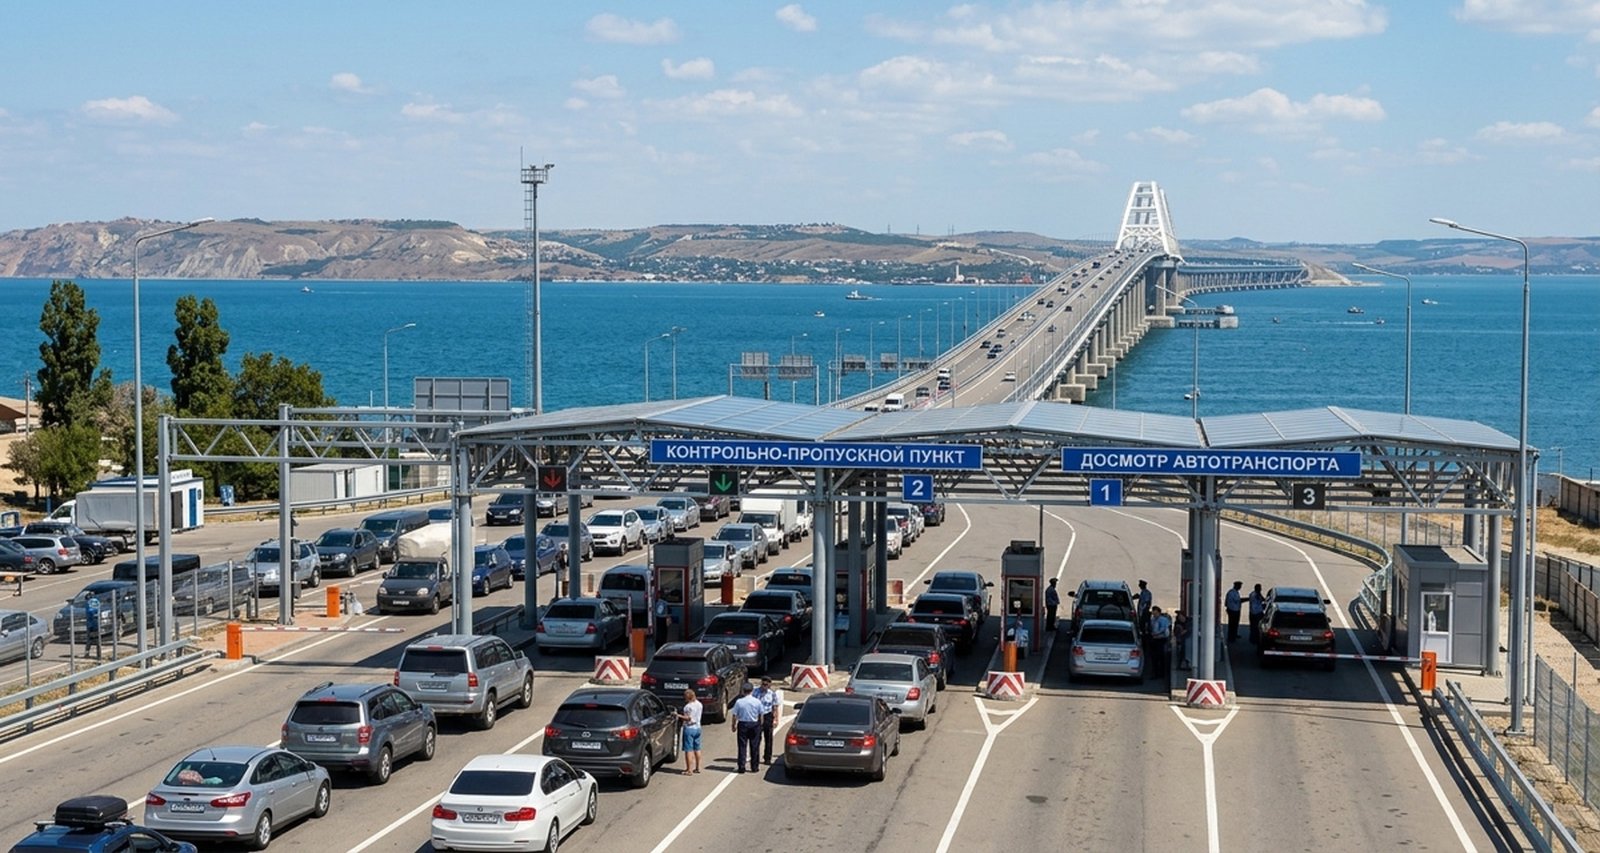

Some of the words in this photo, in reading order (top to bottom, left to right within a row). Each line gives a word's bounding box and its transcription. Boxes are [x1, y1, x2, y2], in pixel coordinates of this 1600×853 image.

[666, 444, 905, 463] КОНТРОЛЬНО-ПРОПУСКНОЙ
[910, 449, 965, 464] ПУНКТ
[1080, 453, 1169, 470] ДОСМОТР
[1173, 455, 1340, 471] АВТОТРАНСПОРТА
[912, 480, 923, 496] 2
[1101, 484, 1109, 501] 1
[1303, 488, 1316, 505] 3
